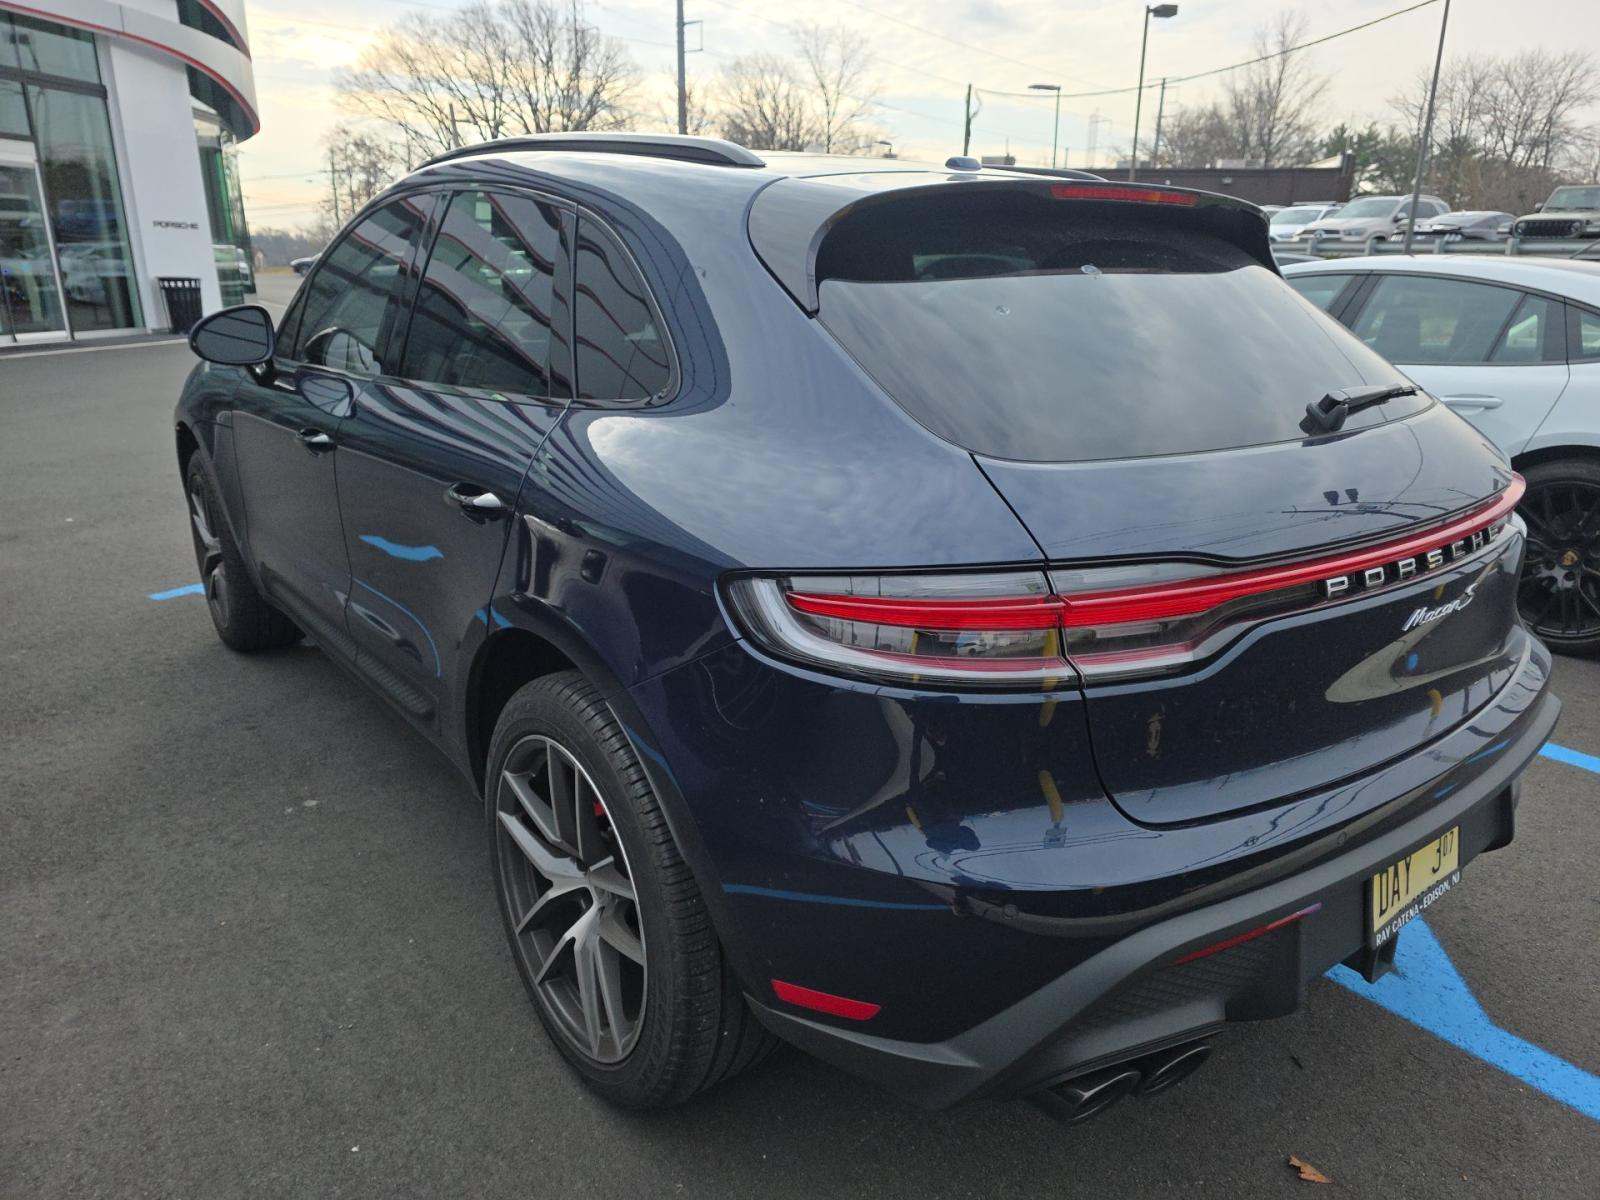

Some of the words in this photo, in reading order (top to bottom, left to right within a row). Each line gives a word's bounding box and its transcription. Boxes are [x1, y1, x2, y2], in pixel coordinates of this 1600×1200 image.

[1326, 525, 1499, 599] PORSCHE
[1402, 600, 1460, 632] Macan
[1456, 583, 1478, 611] S
[1376, 926, 1391, 947] RAY
[1452, 871, 1461, 885] NJ
